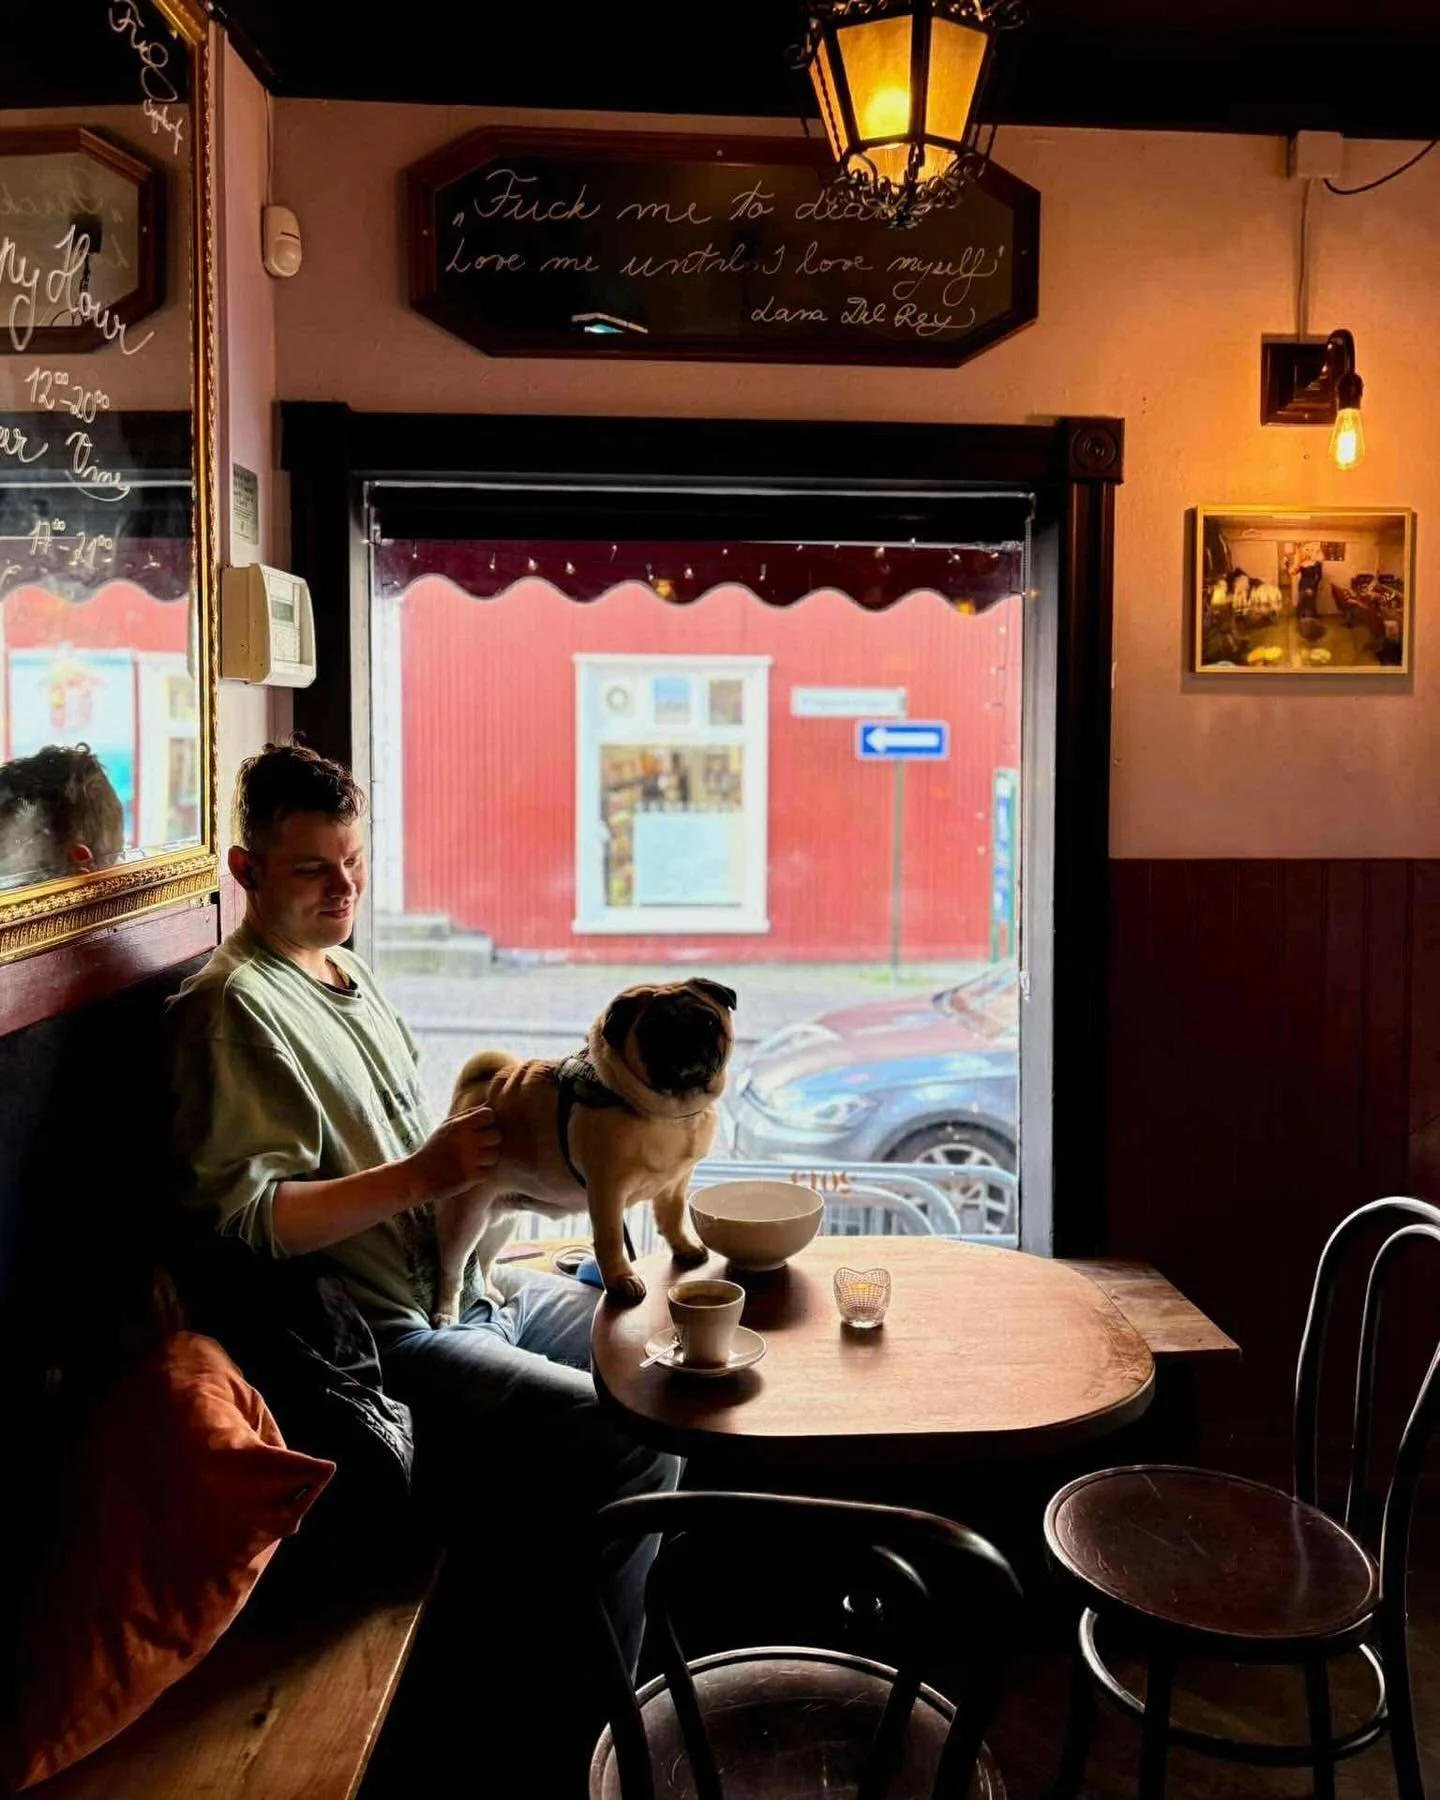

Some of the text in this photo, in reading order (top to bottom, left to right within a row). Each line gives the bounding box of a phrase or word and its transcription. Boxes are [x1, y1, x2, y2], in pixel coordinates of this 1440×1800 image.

[616, 202, 713, 225] me
[729, 180, 776, 221] to
[445, 237, 526, 273] Love
[539, 255, 601, 273] me
[762, 243, 787, 275] I
[795, 240, 875, 276] love
[46, 224, 155, 355] Hour
[751, 295, 976, 337] Lana Del Rey
